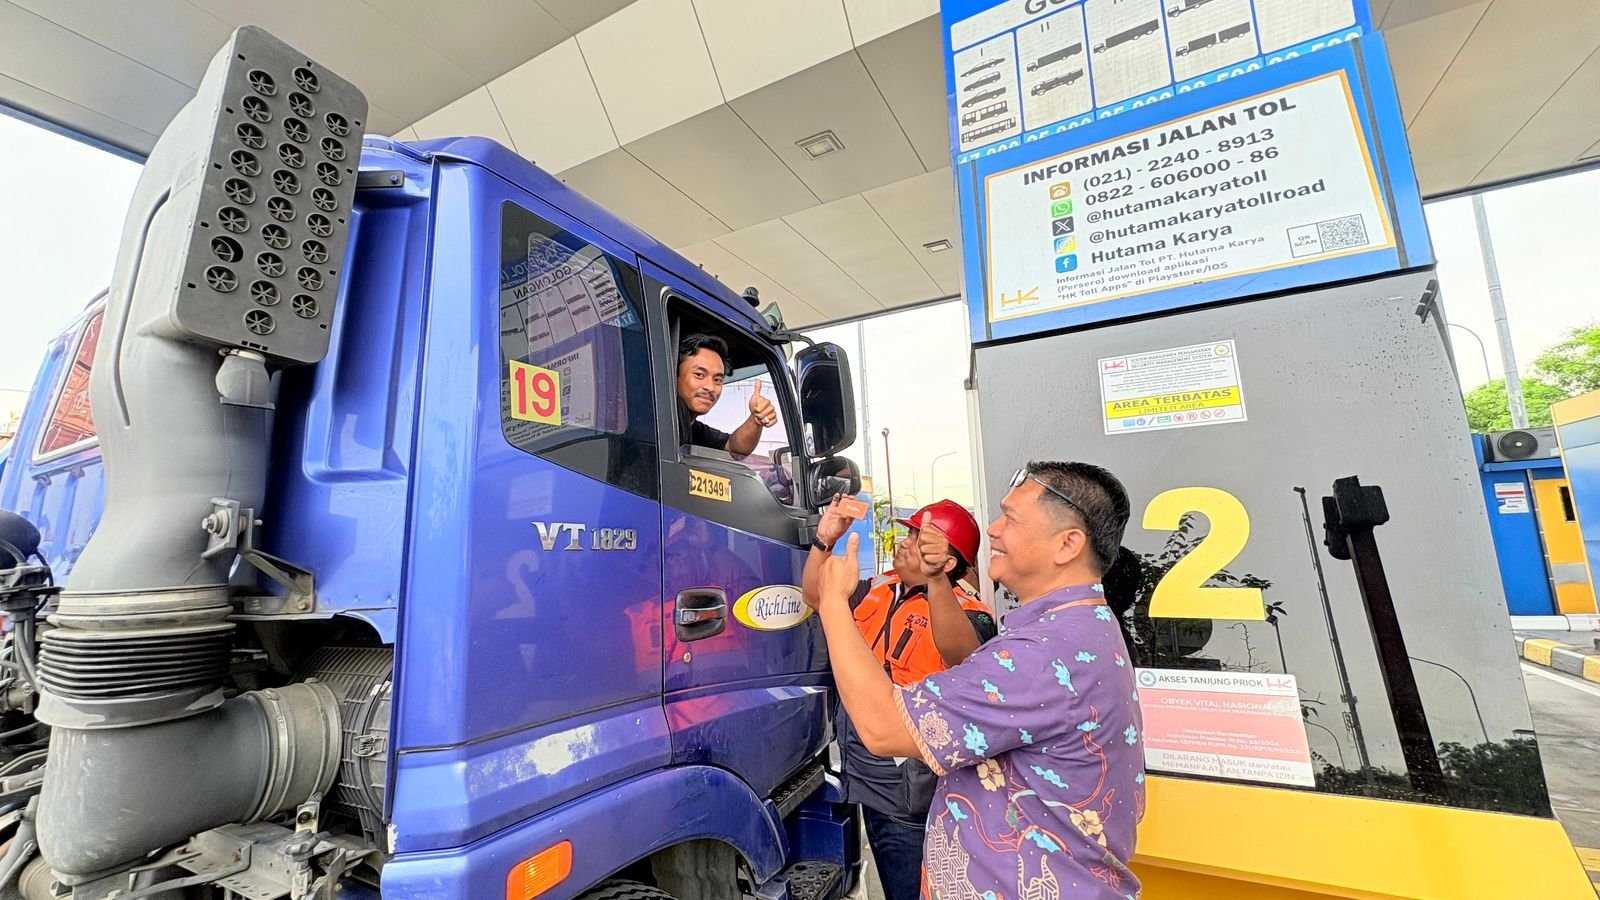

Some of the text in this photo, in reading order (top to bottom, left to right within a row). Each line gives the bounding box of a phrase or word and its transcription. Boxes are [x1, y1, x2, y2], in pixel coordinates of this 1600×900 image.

[1024, 138, 1150, 185] INFORMASI
[1157, 112, 1236, 147] JALAN
[1243, 98, 1296, 120] TOL
[1084, 168, 1132, 190] (021)
[1148, 149, 1200, 172] 2240
[1218, 128, 1274, 152] 8913
[1086, 184, 1134, 206] 0822
[1150, 160, 1230, 188] 606000
[1250, 146, 1279, 164] 86
[1086, 170, 1268, 224] @hutamakaryatoll
[1089, 178, 1326, 244] @hutamakaryatollroad
[1056, 236, 1264, 284] Informasi Jalan Tol PT. Hutama Karya
[1092, 225, 1232, 264] Hutama Karya
[1294, 240, 1317, 248] SCAN
[1058, 256, 1208, 293] (Persero) download aplikasi
[1080, 288, 1098, 298] Toll
[1148, 262, 1229, 284] Playstore/IOS
[1000, 286, 1040, 308] HK
[1104, 360, 1125, 370] HK
[514, 366, 556, 418] 19
[1113, 400, 1150, 410] AREA
[1153, 389, 1232, 404] TERBATAS
[1139, 402, 1204, 415] LIMITED AREA
[531, 522, 637, 550] VT 1829
[1142, 486, 1266, 621] 2
[756, 594, 801, 620] RichLine
[1158, 675, 1292, 688] AKSES TANJUNG PRIOK HK
[1160, 697, 1192, 706] OBYEK
[1194, 699, 1219, 707] VITAL
[1162, 752, 1291, 771] DILARANG MASUK dan/atau
[1162, 761, 1240, 774] MEMANFAATAN
